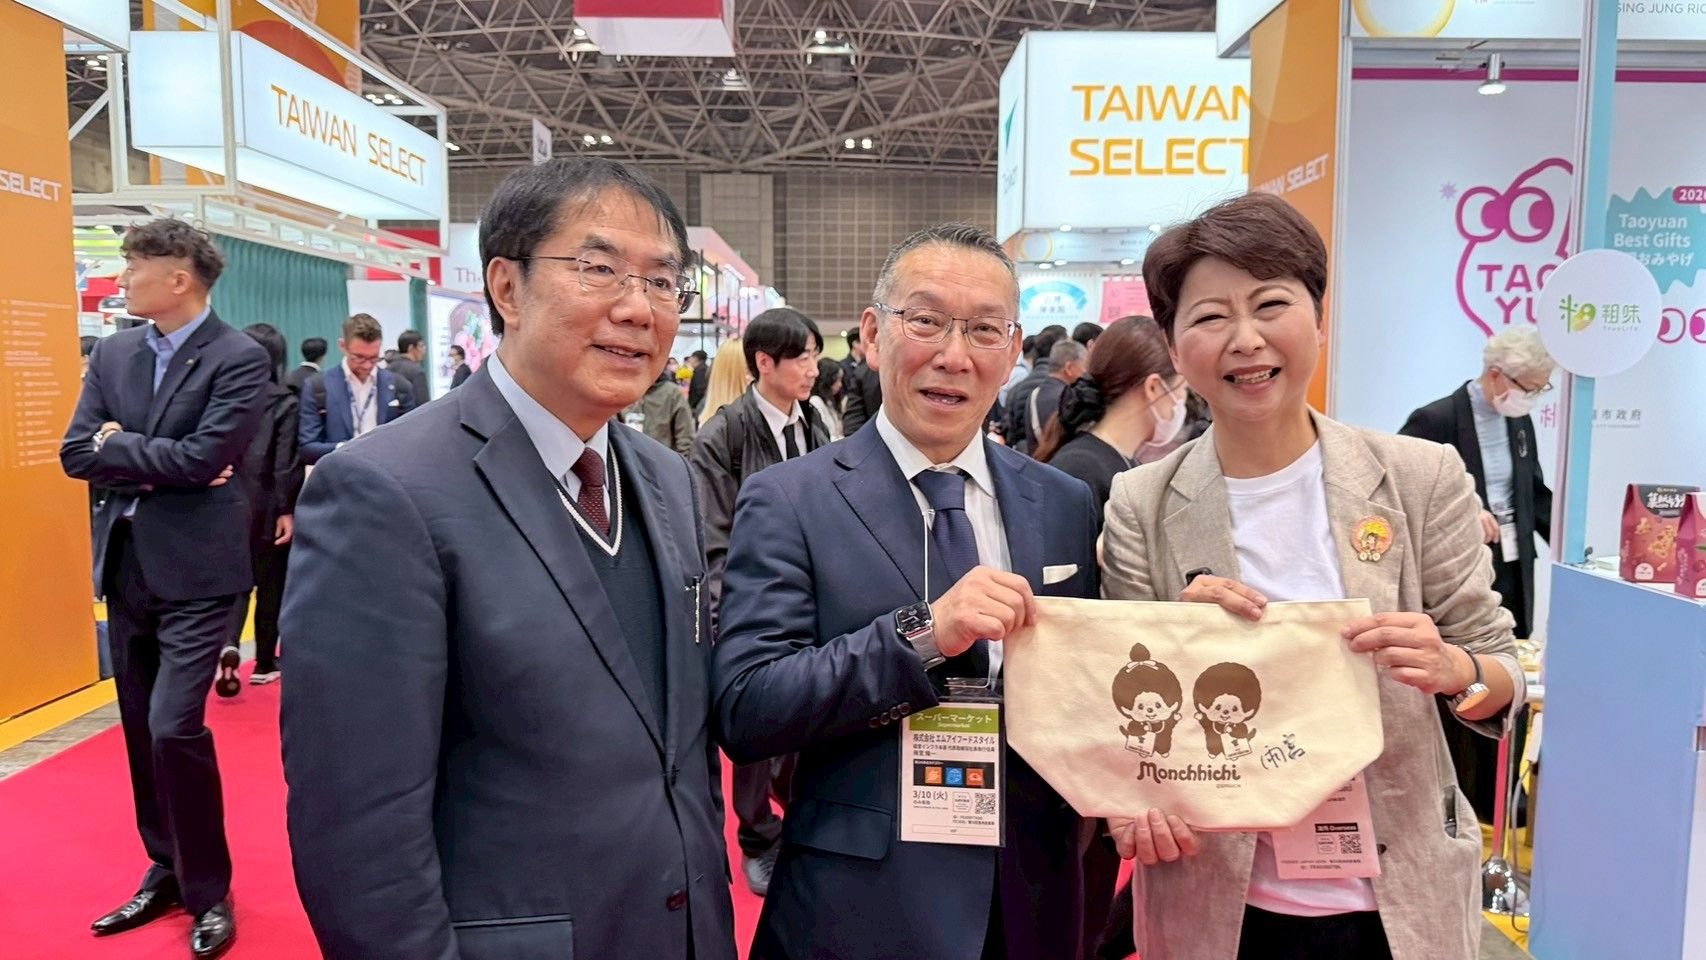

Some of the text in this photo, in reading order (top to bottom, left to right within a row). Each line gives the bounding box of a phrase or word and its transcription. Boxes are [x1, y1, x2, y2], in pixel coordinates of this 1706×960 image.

[1648, 3, 1684, 14] JUNG
[1072, 84, 1250, 121] TAIWAN
[271, 84, 427, 186] TAIWAN SELECT
[1070, 138, 1250, 176] SELECT
[1287, 152, 1329, 192] SELECT
[0, 169, 62, 202] SELECT
[1619, 214, 1688, 231] Taoyuan
[1614, 232, 1691, 247] Best Gifts
[1628, 252, 1694, 267] おみやげ
[916, 713, 992, 723] スーパーマーケット
[1137, 761, 1241, 784] Monchhichi
[913, 790, 948, 801] 3/10 (火)
